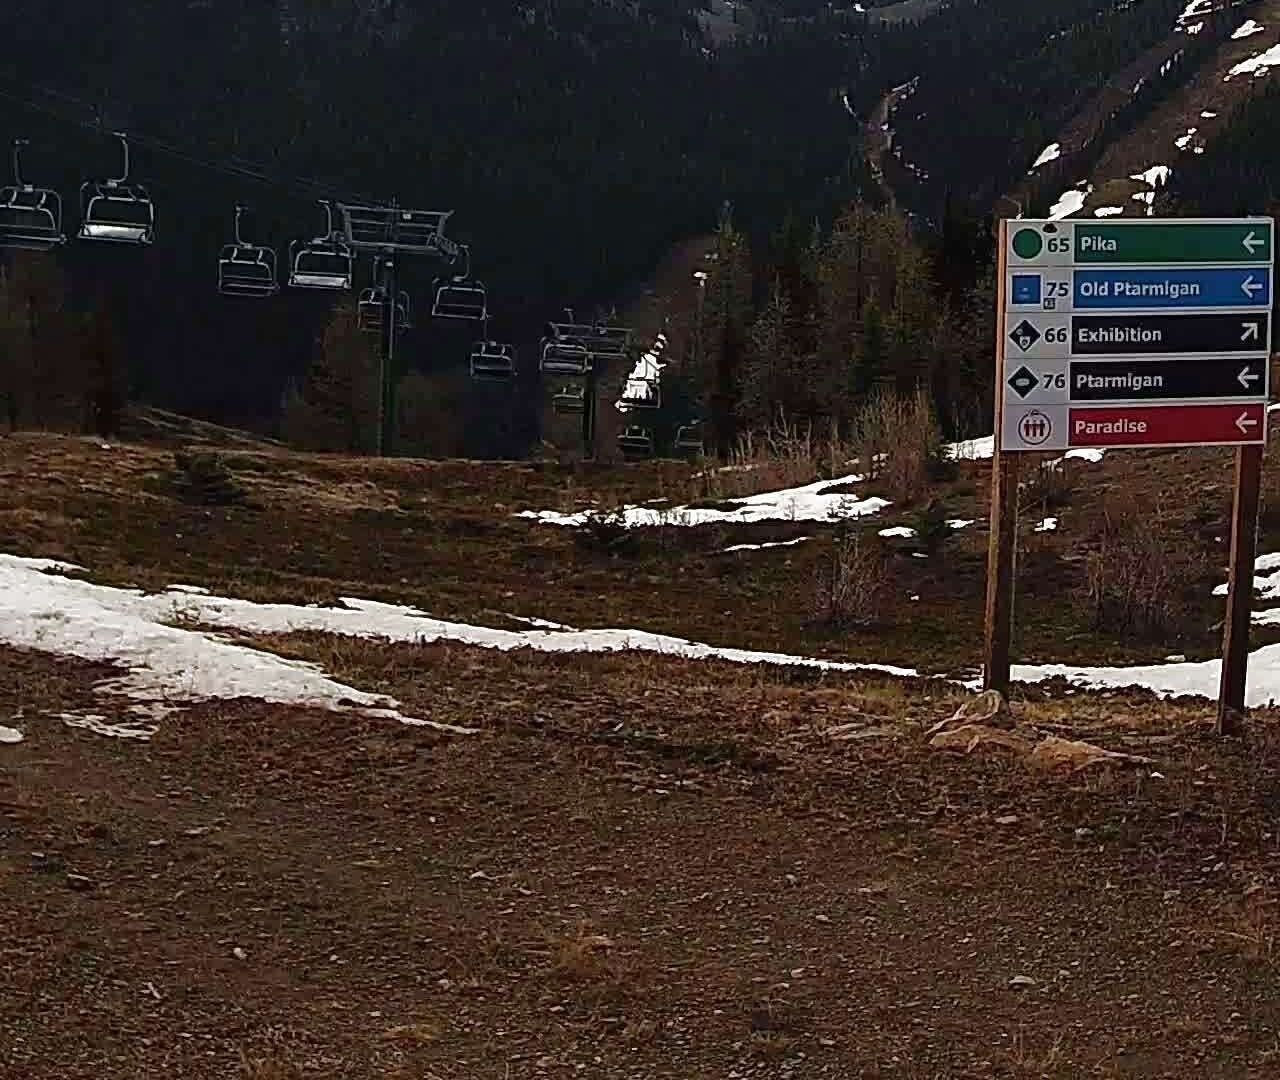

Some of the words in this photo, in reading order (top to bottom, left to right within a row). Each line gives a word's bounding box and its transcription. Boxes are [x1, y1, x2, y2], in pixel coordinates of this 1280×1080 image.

[1047, 237, 1070, 253] 65
[1080, 236, 1117, 252] Pika
[1046, 282, 1069, 297] 75
[1080, 281, 1108, 297] Old
[1114, 280, 1200, 298] Ptarmigan
[1044, 327, 1067, 343] 66
[1078, 325, 1162, 343] Exhibition
[1042, 373, 1065, 389] 76
[1076, 372, 1163, 390] Ptarmigan
[1075, 418, 1147, 435] Paradise
